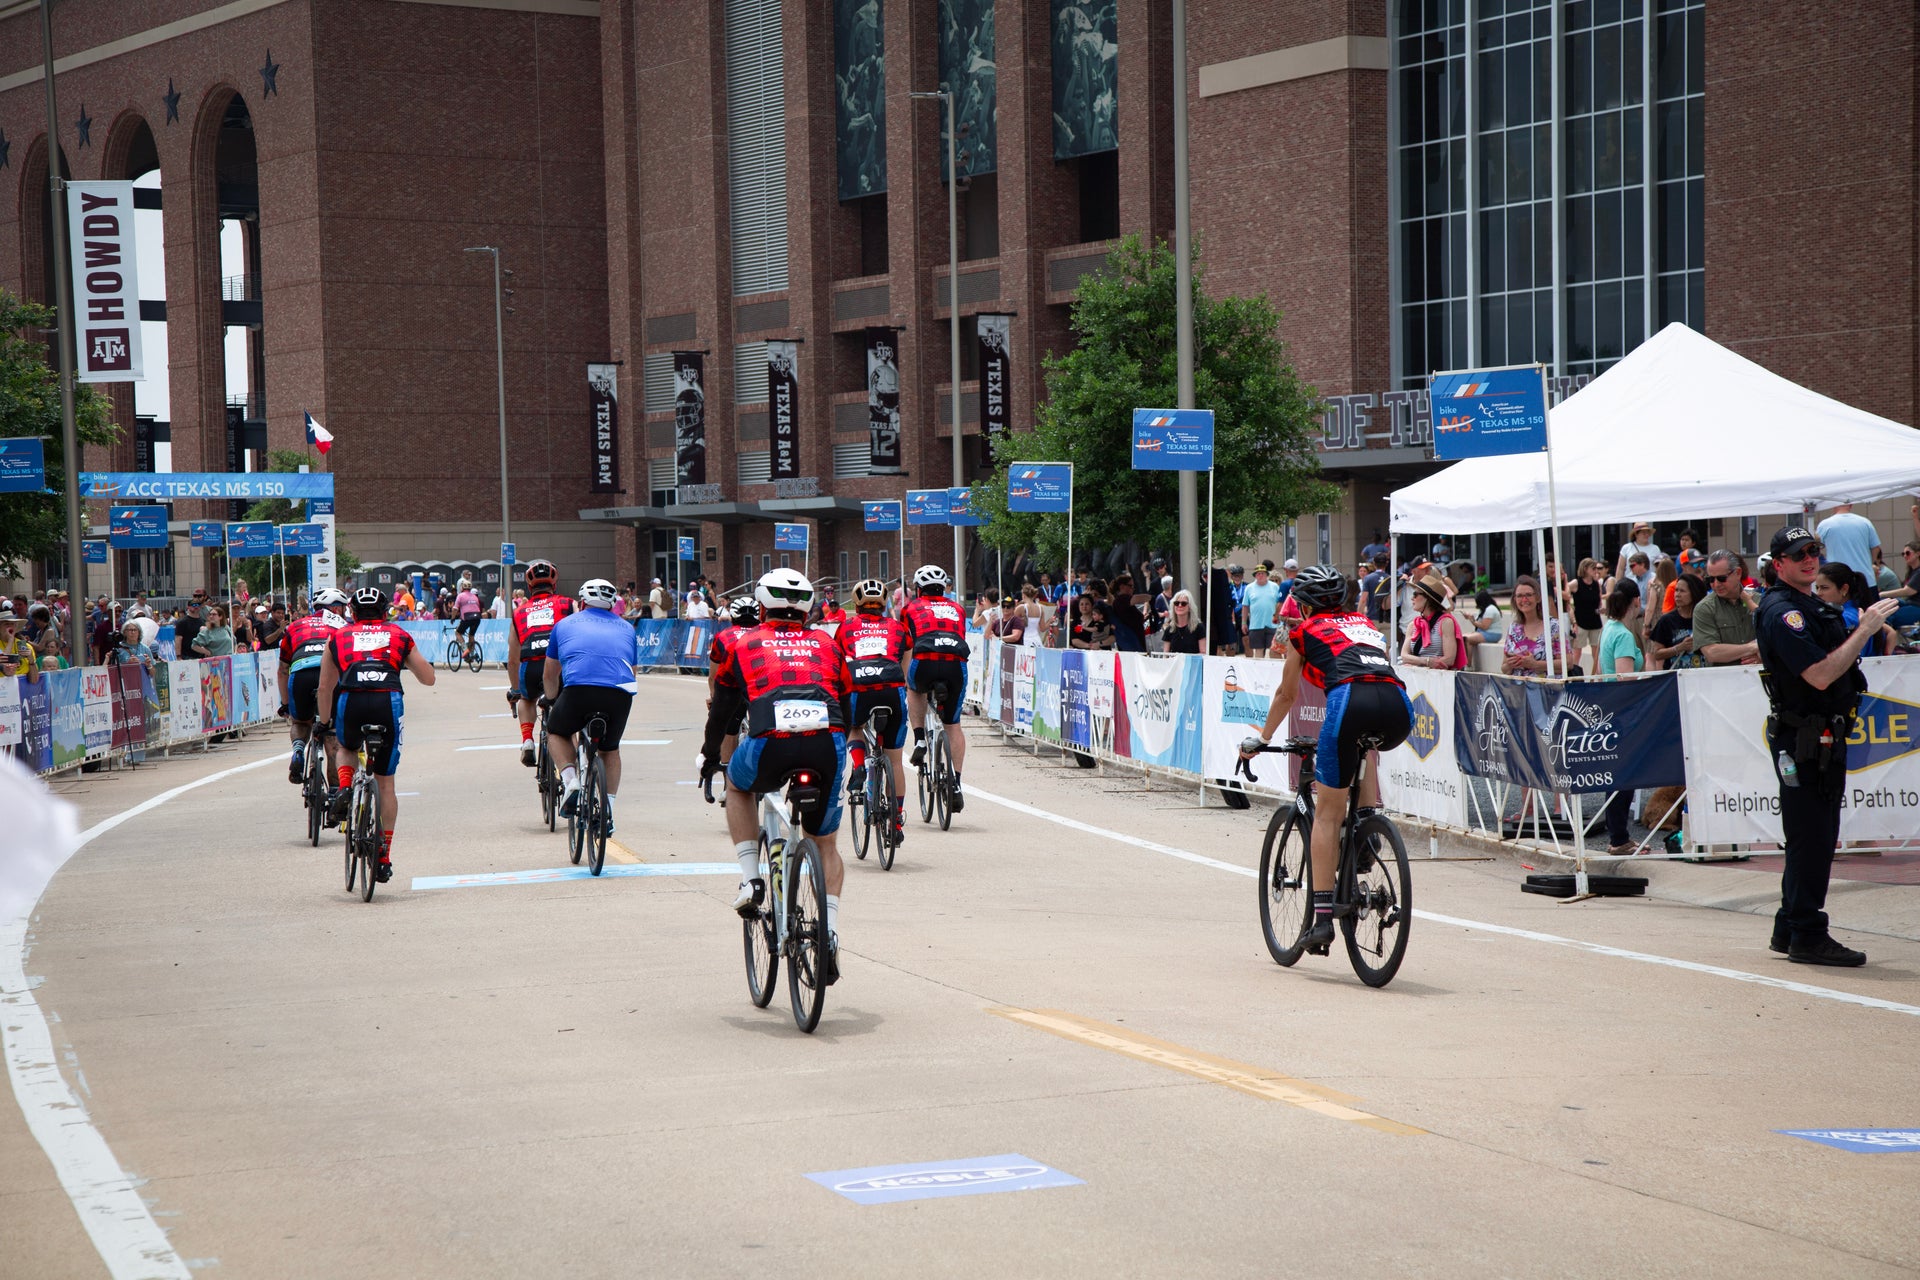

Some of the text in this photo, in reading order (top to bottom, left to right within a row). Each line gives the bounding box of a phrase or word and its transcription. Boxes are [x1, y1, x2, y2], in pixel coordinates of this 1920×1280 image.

[81, 191, 125, 321] HOWDY
[987, 358, 1003, 416] TEXAS
[1440, 406, 1457, 415] bike
[1478, 402, 1495, 418] ACC
[1323, 388, 1434, 449] OF TH
[1440, 415, 1472, 434] MS
[1480, 415, 1544, 428] TEXAS MS 150
[776, 382, 792, 472] TEXAS A&M
[1138, 430, 1151, 438] bike
[1166, 431, 1178, 443] ACC
[596, 401, 612, 485] TEXAS A&M
[871, 430, 896, 457] 12
[1138, 438, 1161, 452] MS
[1166, 443, 1187, 451] TEXAS
[93, 482, 120, 497] MS
[126, 482, 284, 497] ACC TEXAS MS 150
[1786, 529, 1810, 542] POLICE
[525, 601, 554, 613] CYCLING
[532, 598, 548, 607] NOV
[569, 616, 629, 629] SCOTLAND
[1323, 615, 1368, 624] CYCLING
[852, 629, 888, 637] CYCLING
[531, 639, 551, 650] NO
[761, 639, 820, 648] CYCLING
[934, 637, 959, 647] NOV
[773, 649, 813, 657] TEAM
[356, 671, 388, 682] NOV
[855, 666, 884, 678] NOV
[1299, 705, 1327, 723] AGGIELAN
[1478, 707, 1509, 756] Aztec
[1845, 713, 1912, 745] BLE
[1549, 718, 1619, 769] Aztec
[1567, 755, 1591, 763] EVENTS
[1598, 753, 1619, 761] TENTS
[1713, 791, 1782, 816] Helping
[1853, 786, 1895, 808] Path
[1898, 788, 1920, 807] to
[867, 1170, 1015, 1188] NOBLE
